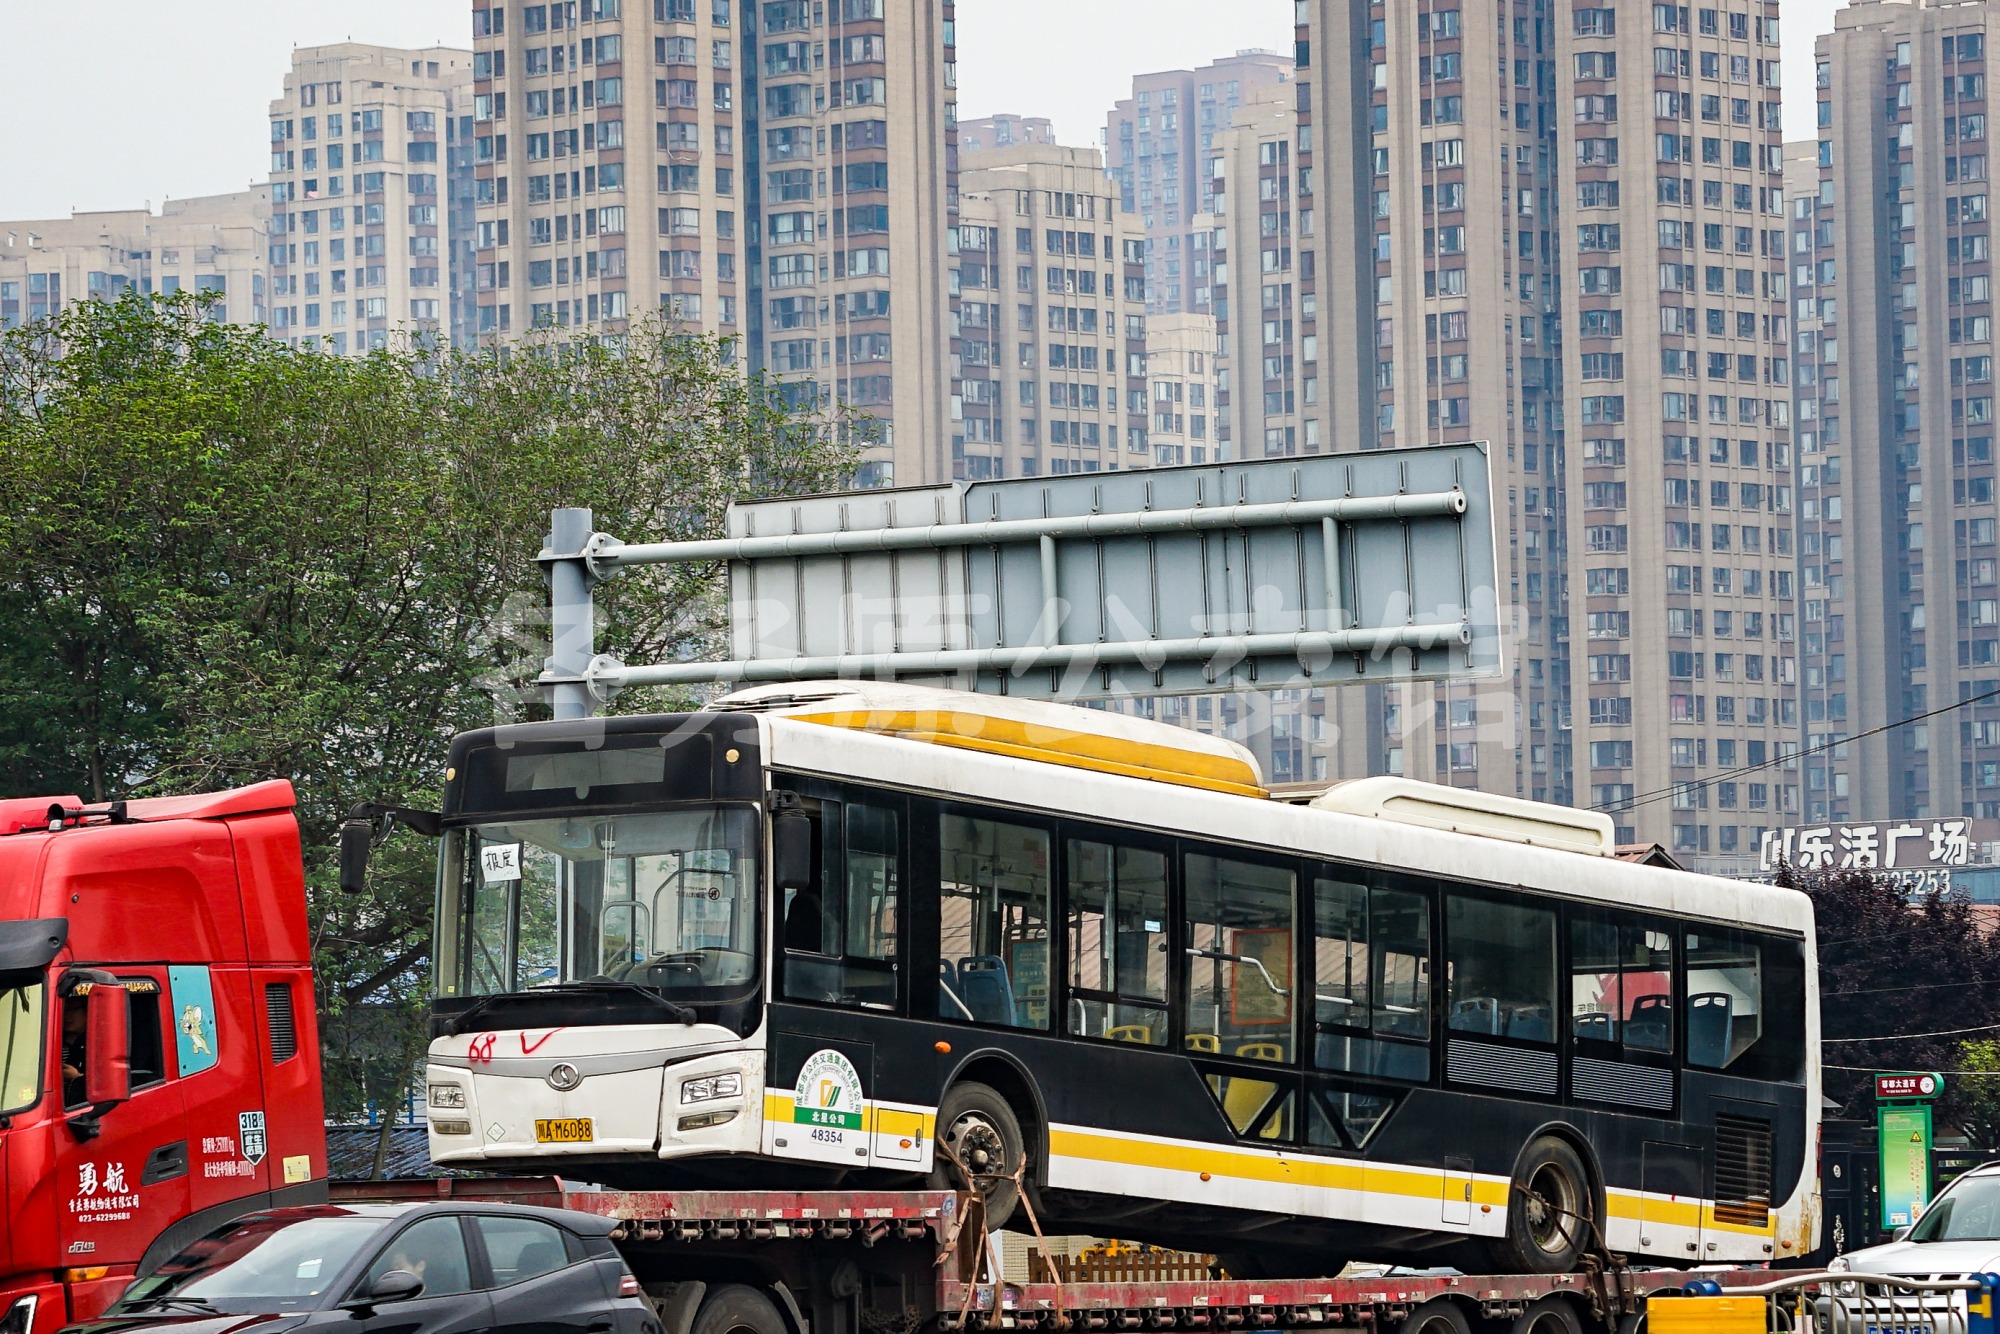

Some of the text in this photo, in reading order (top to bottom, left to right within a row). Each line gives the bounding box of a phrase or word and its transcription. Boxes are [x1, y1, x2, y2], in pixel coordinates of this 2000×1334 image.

[468, 1031, 497, 1064] 68
[240, 1113, 258, 1129] 318
[811, 1128, 843, 1144] 48354
[77, 1161, 129, 1196] 勇航
